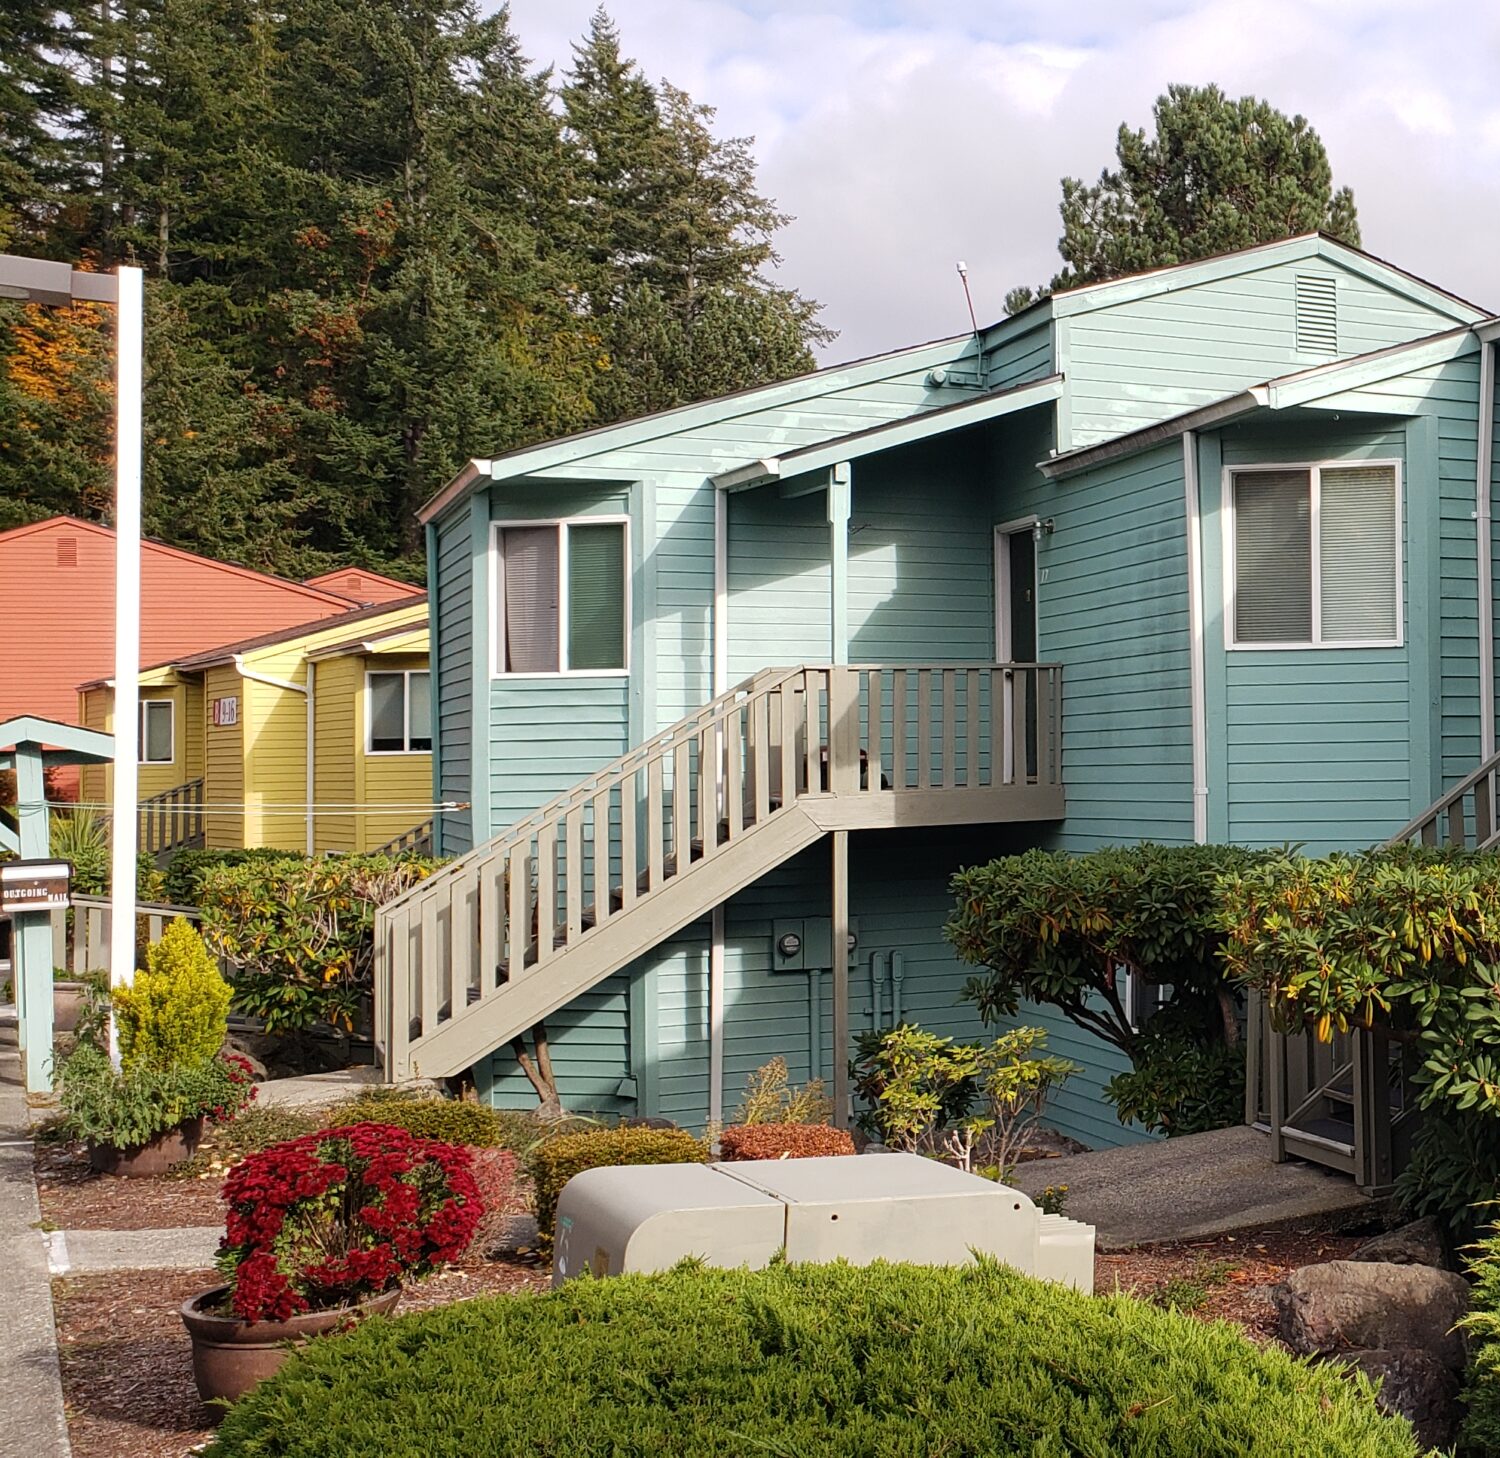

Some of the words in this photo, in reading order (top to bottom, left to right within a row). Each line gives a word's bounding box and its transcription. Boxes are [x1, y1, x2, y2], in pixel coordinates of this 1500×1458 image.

[222, 700, 235, 723] 9-16
[3, 888, 48, 899] OUTGOING
[48, 893, 68, 902] MAIL
